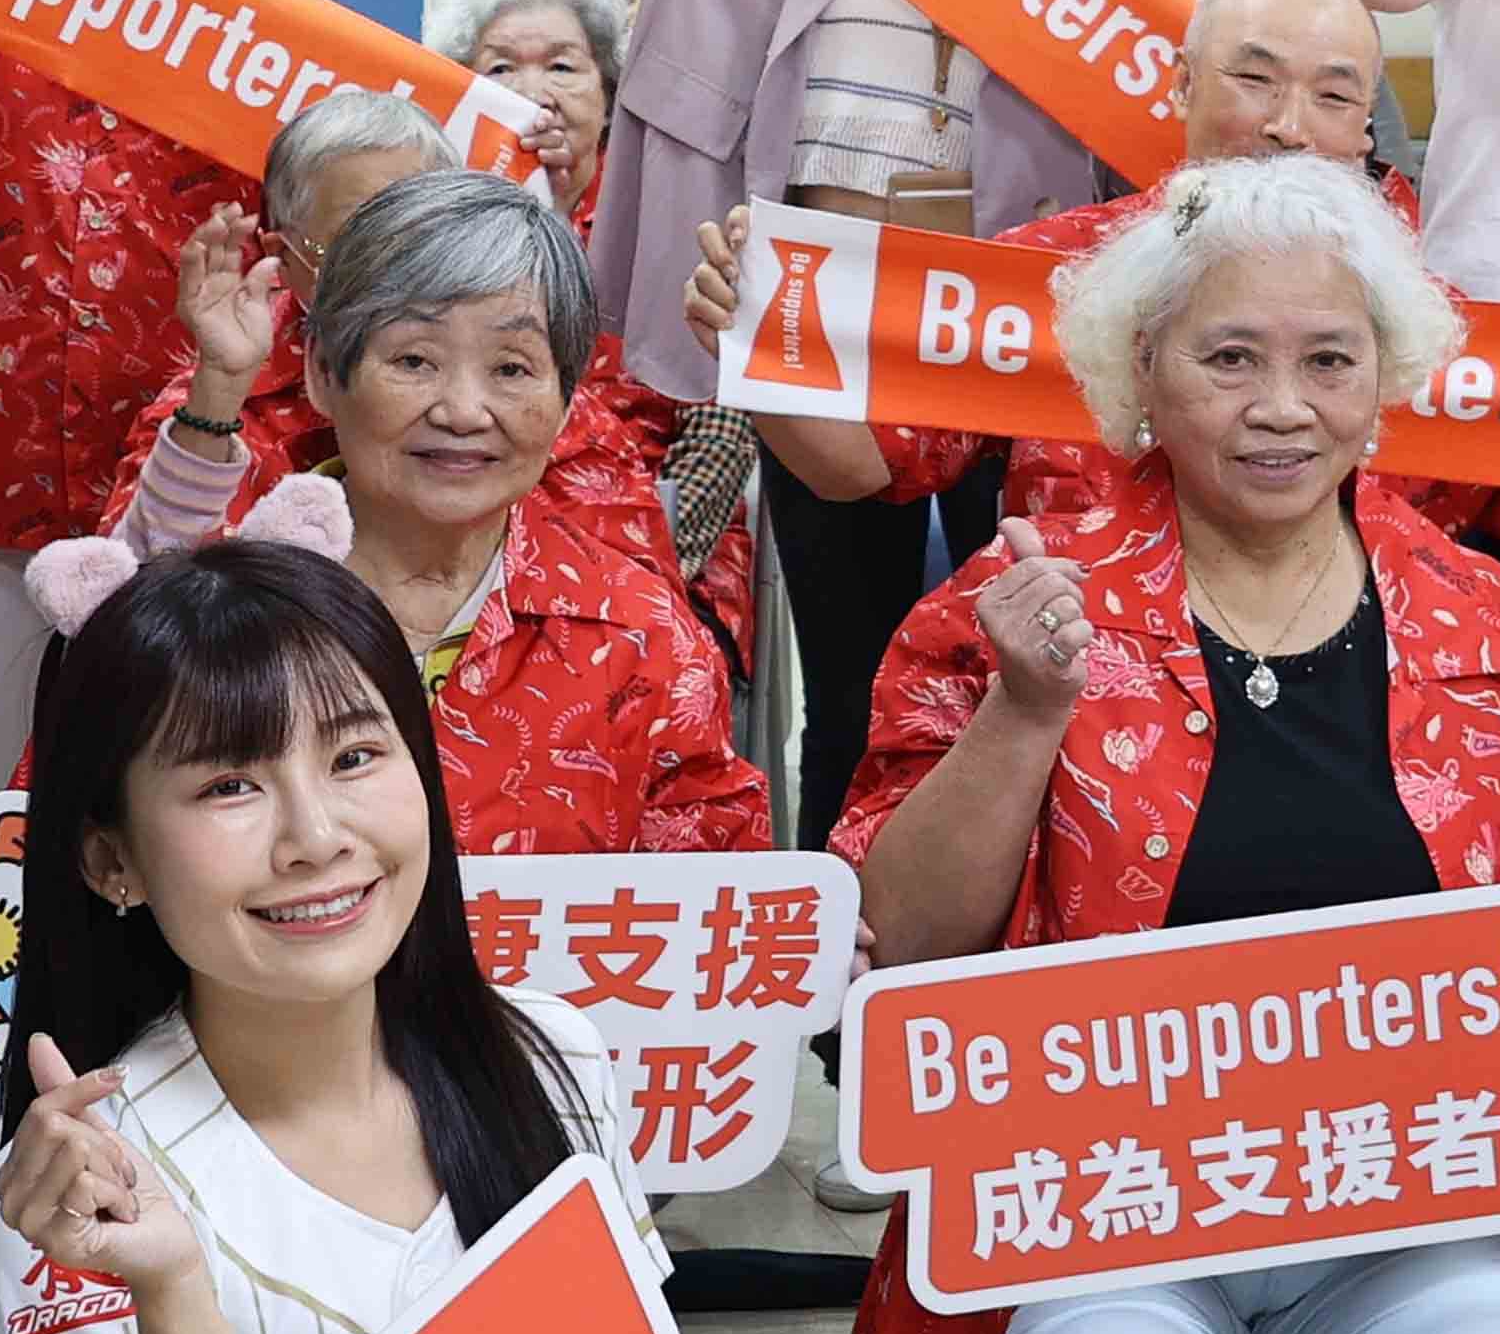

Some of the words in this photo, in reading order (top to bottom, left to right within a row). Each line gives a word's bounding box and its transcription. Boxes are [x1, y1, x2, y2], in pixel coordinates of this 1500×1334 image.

[919, 269, 1032, 371] Be
[610, 1040, 758, 1164] 形
[905, 1016, 1010, 1114] Be
